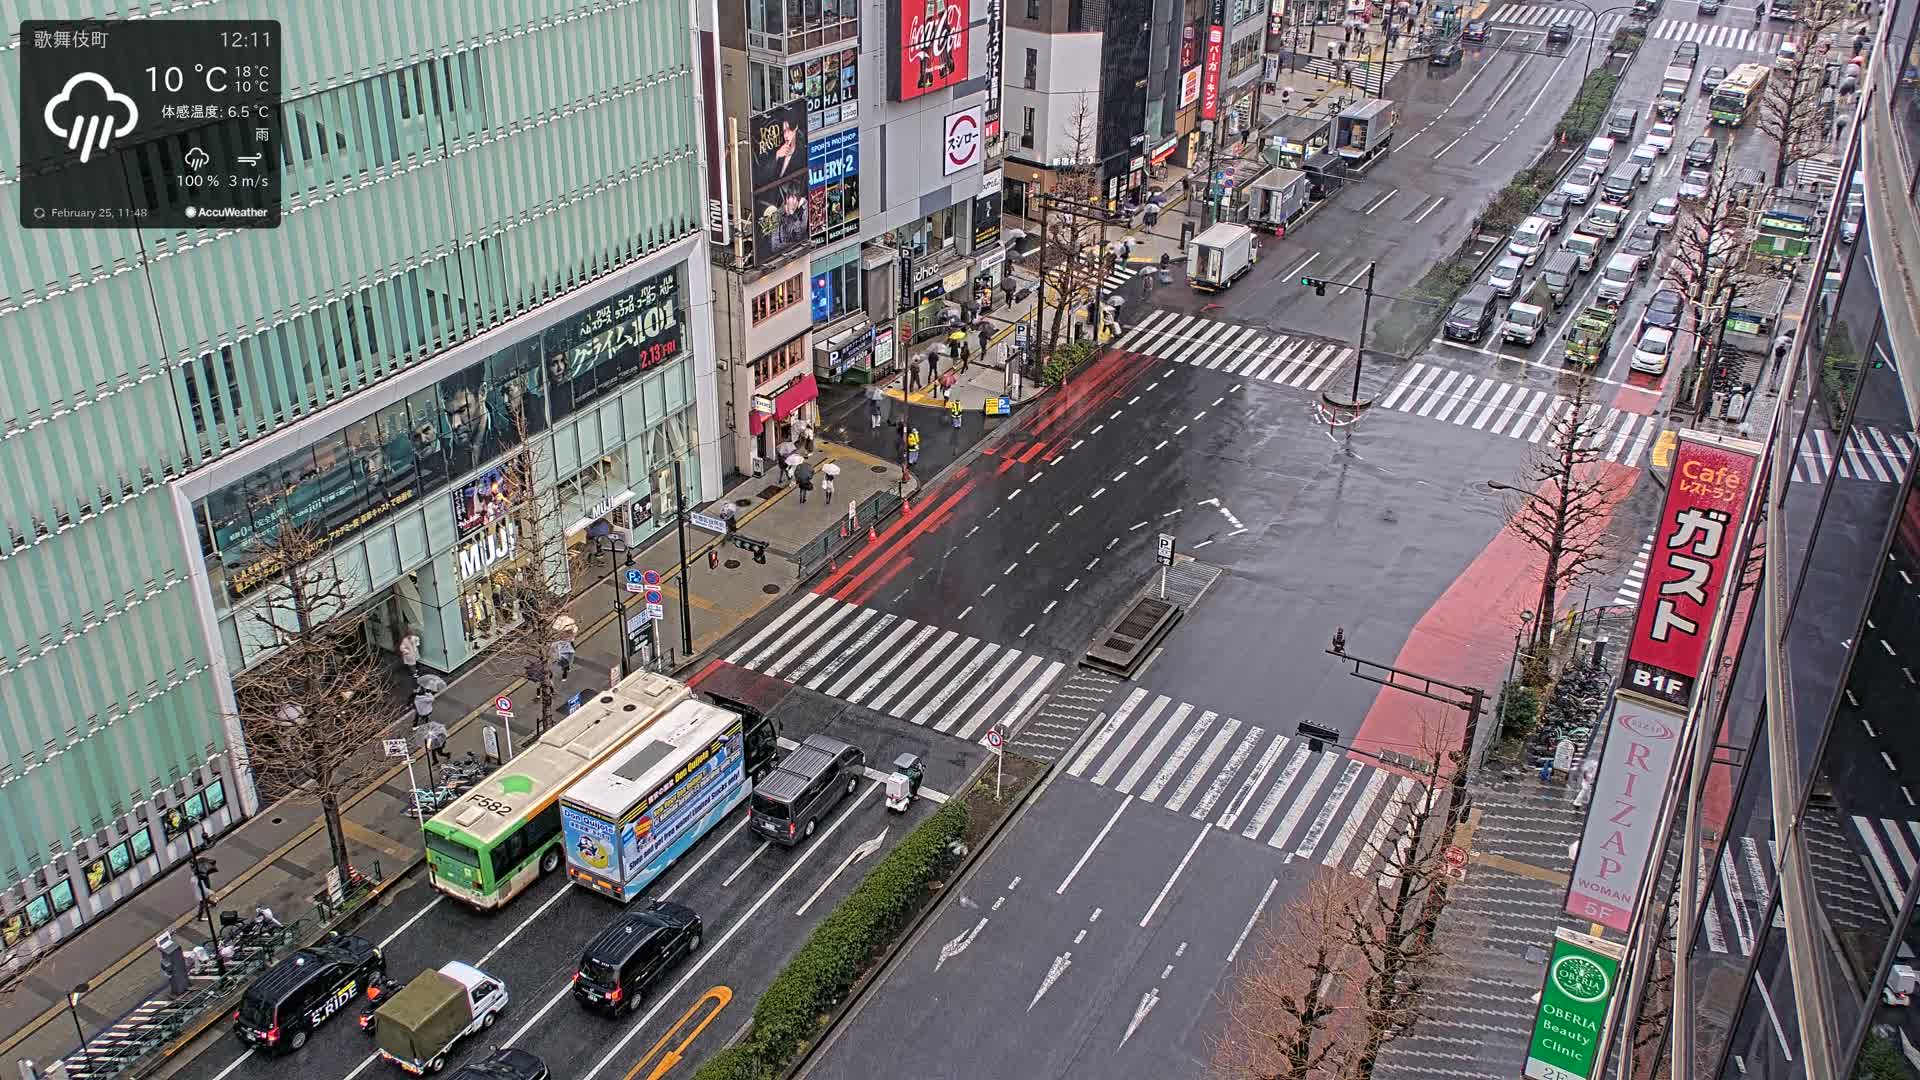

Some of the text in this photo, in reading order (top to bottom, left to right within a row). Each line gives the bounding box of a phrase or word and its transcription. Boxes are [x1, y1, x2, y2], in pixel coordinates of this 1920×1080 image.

[908, 4, 962, 62] Coca-Cola
[1206, 45, 1220, 110] バーガーキング
[811, 142, 831, 154] SPORTS
[842, 132, 856, 144] SHOP
[947, 132, 979, 152] スシロー
[709, 199, 723, 232] MUJI
[902, 249, 910, 258] P
[617, 294, 634, 308] マーク
[595, 305, 612, 321] クリス
[1017, 325, 1026, 335] P
[640, 339, 677, 369] 2.13 FRI
[829, 350, 840, 367] P
[998, 398, 1006, 409] P
[1681, 459, 1741, 489] Café
[1678, 478, 1736, 502] レストラン
[591, 497, 617, 520] MUJI
[459, 522, 516, 581] MUJI
[1160, 539, 1169, 549] P
[629, 572, 636, 581] P
[1650, 507, 1729, 642] ガスト
[1632, 668, 1684, 695] B1F
[1631, 719, 1663, 734] RIZAP
[675, 768, 688, 783] Don
[467, 794, 512, 817] F582
[1599, 741, 1651, 881] RIZAP
[564, 809, 582, 821] Don
[583, 816, 615, 835] Quijote
[1578, 876, 1632, 904] WOMAN
[1582, 901, 1615, 920] 5F
[1559, 969, 1601, 990] OBERIA
[312, 983, 358, 1028] S.RIDE
[1543, 1003, 1597, 1032] OBERIA
[1543, 1019, 1590, 1046] Beauty
[1542, 1038, 1583, 1061] Clinic
